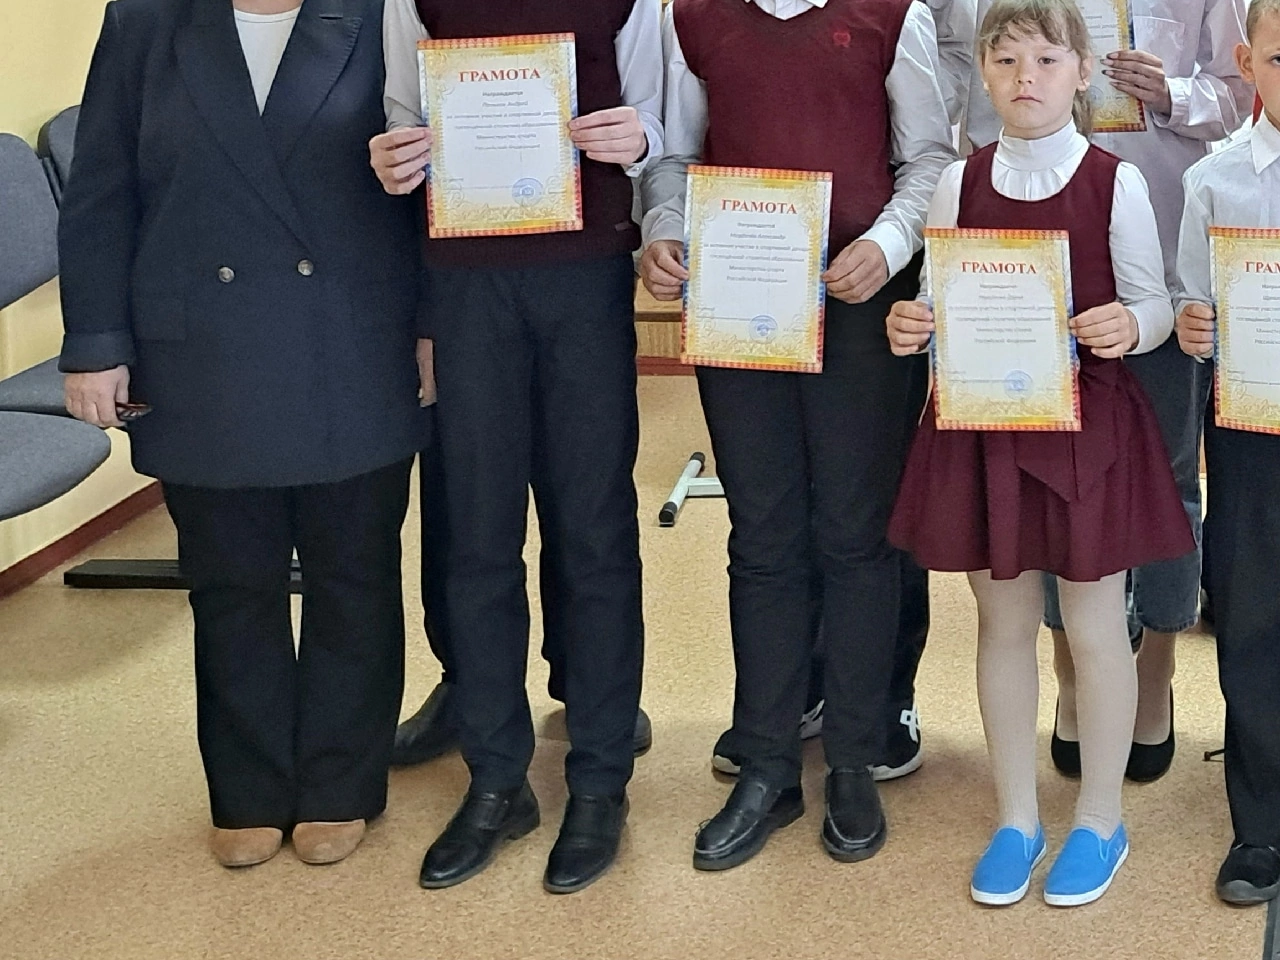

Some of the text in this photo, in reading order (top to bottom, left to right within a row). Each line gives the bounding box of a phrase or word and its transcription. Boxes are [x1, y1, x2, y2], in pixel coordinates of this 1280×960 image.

[459, 68, 542, 82] ГРАМОТА
[721, 198, 798, 214] ГРАМОТА
[961, 262, 1037, 274] ГРАМОТА
